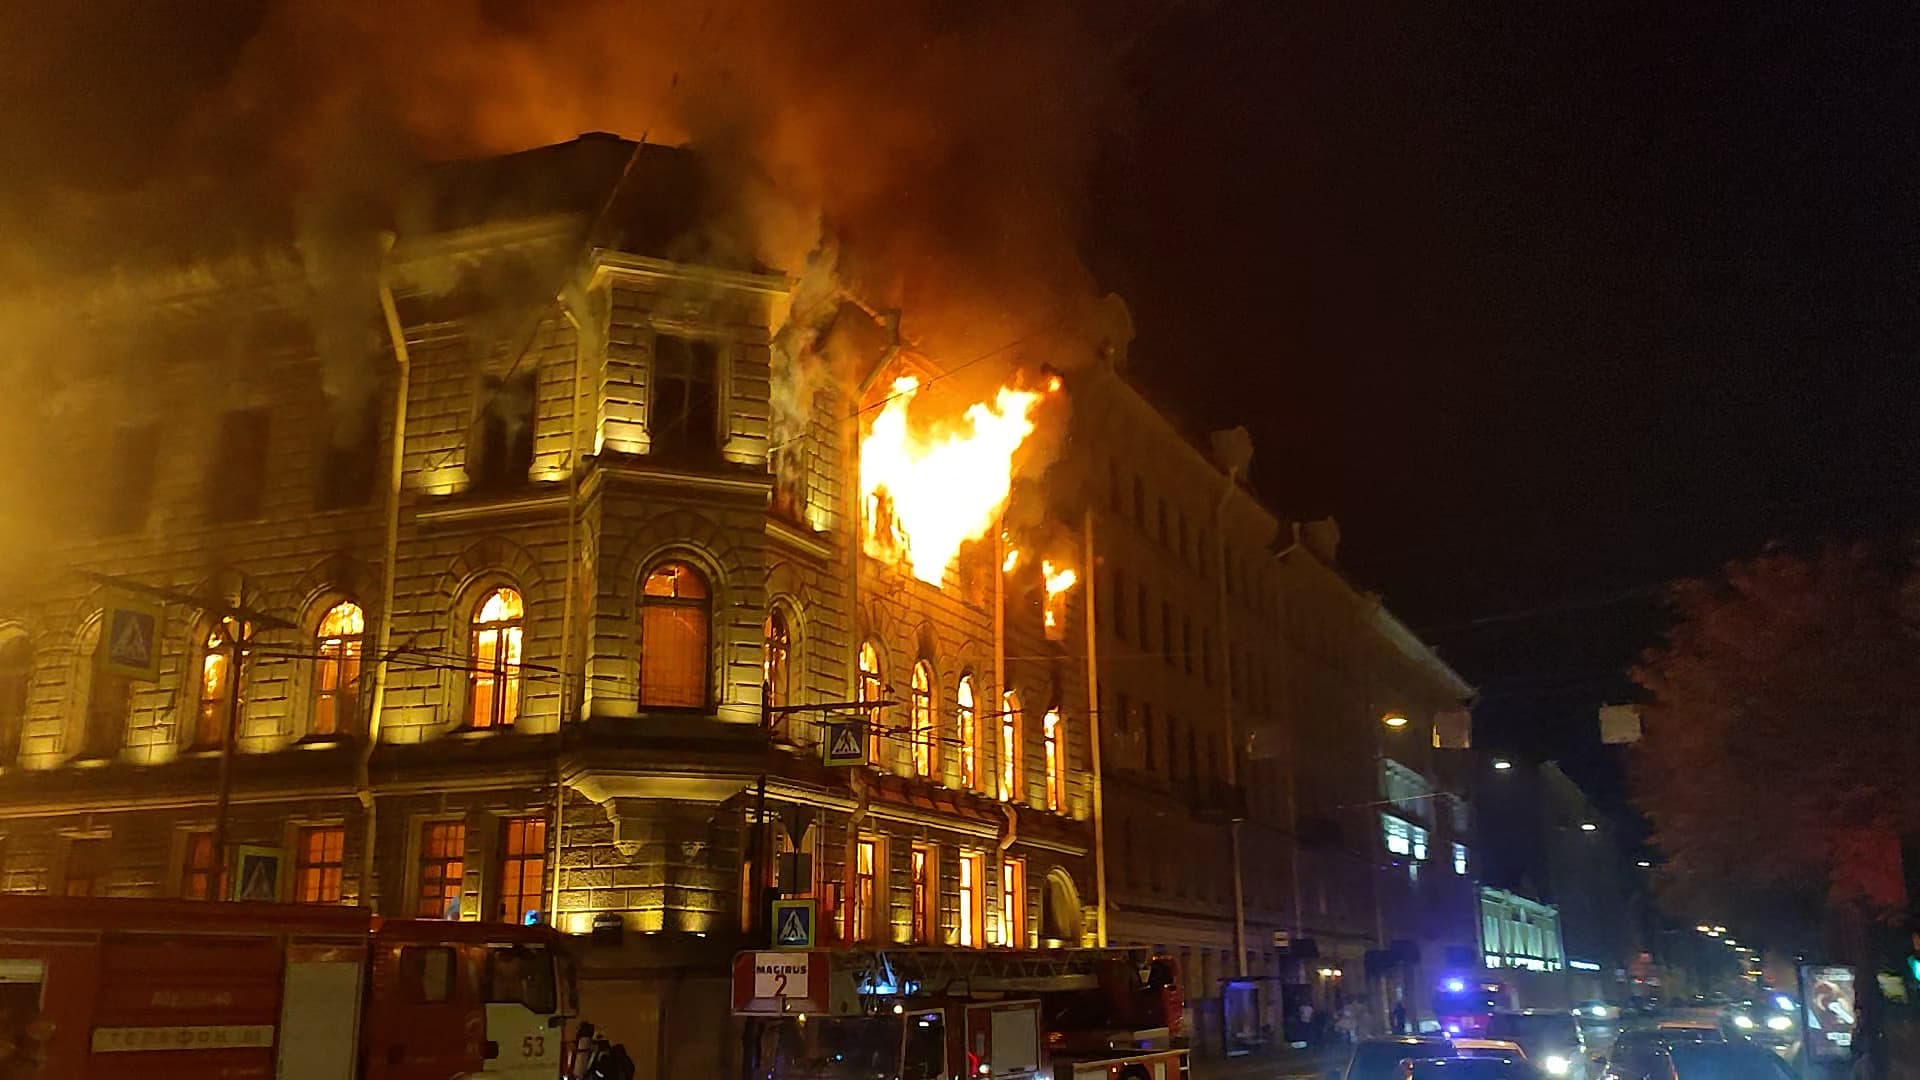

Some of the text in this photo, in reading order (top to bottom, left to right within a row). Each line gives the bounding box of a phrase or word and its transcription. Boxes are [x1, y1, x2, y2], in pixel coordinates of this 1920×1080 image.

[756, 965, 807, 975] MAGIRUS
[774, 974, 787, 997] 2
[522, 1036, 545, 1057] 53
